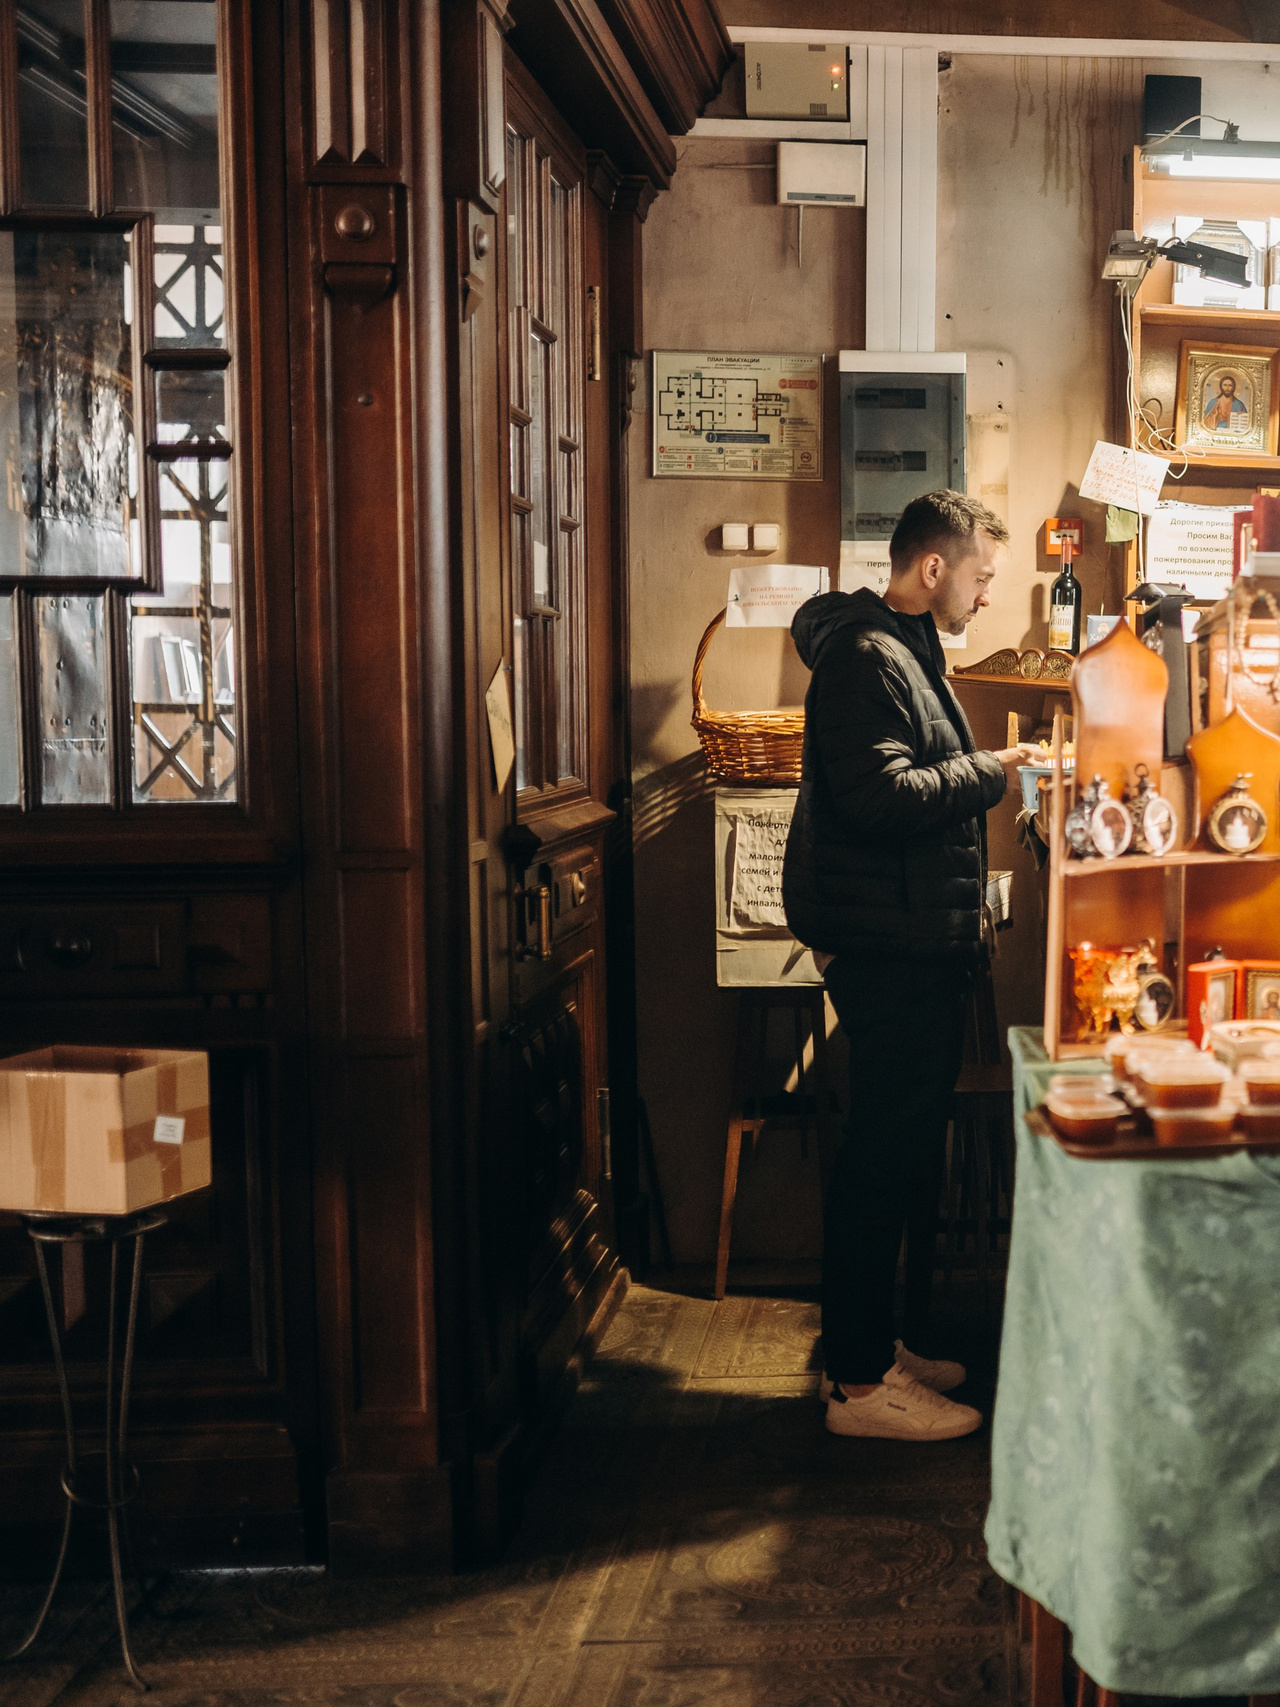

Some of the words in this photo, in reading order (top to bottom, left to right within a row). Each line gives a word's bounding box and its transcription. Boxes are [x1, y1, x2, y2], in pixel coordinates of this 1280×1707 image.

[1170, 517, 1204, 527] Дорогие
[1187, 531, 1218, 541] Просим
[1154, 556, 1216, 565] пожертвования
[1166, 569, 1213, 577] наличными
[741, 867, 771, 876] семей
